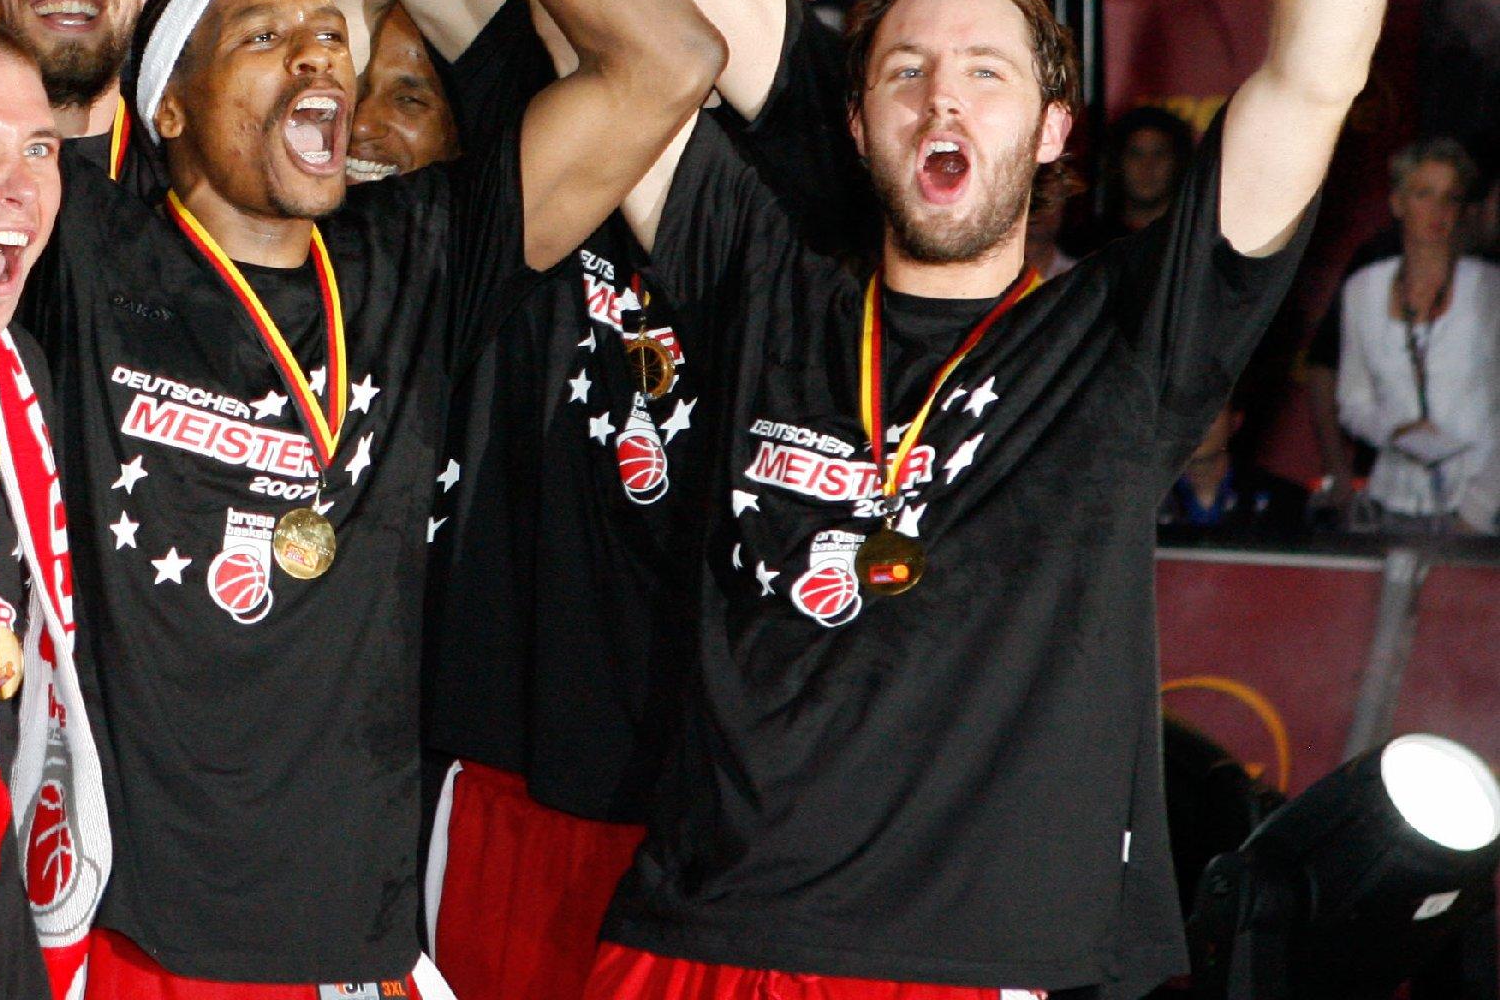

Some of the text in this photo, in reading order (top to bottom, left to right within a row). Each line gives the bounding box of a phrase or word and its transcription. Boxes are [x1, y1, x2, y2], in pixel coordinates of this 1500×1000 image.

[111, 366, 250, 419] DEUTSCHER
[125, 397, 319, 475] MEISTER
[750, 419, 855, 458] DEUTSCHER
[249, 477, 317, 500] 2007
[227, 507, 275, 528] brose
